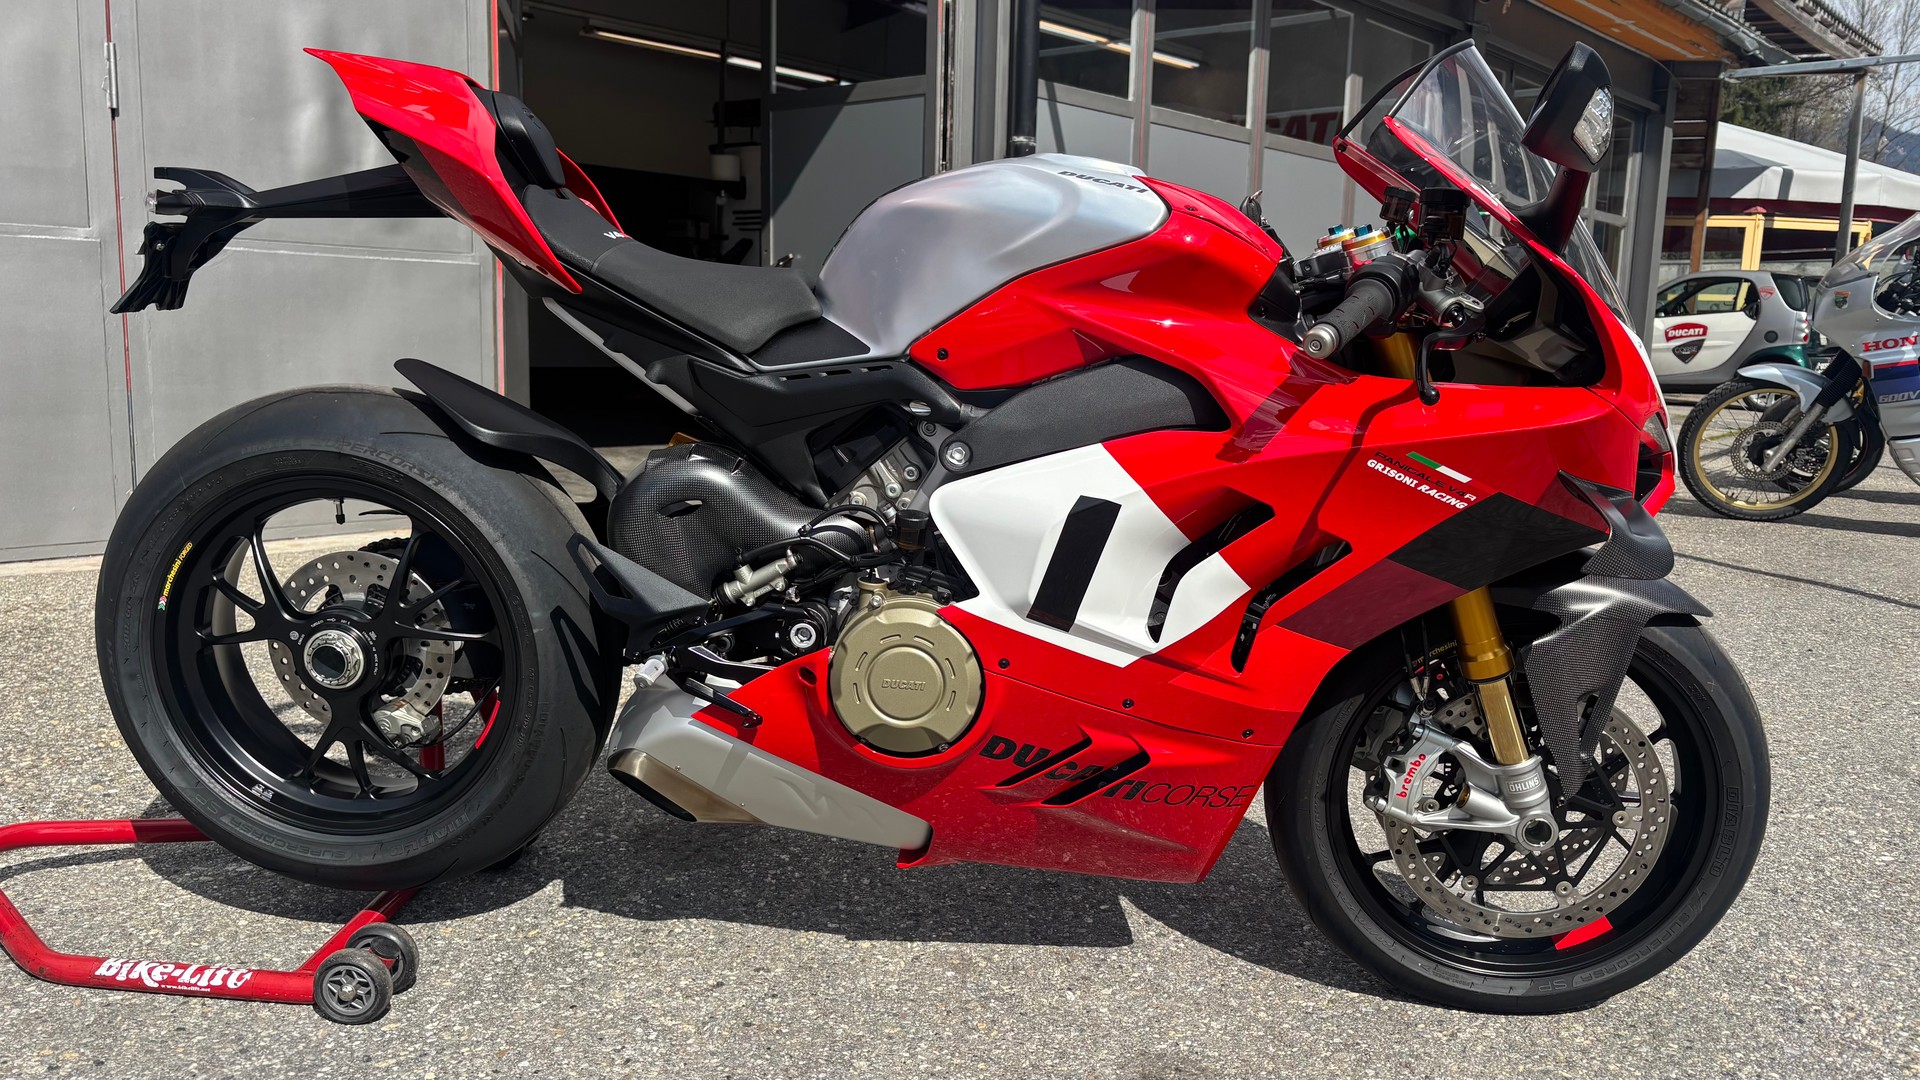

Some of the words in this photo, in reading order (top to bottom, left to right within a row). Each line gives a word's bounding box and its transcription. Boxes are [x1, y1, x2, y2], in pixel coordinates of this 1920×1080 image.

[1057, 170, 1149, 194] DUCATI
[1667, 327, 1704, 338] DUCATI
[1366, 459, 1419, 488] GRISONI
[1416, 484, 1469, 509] RACING
[1374, 451, 1446, 488] PANIGALE
[162, 558, 182, 597] marchesini
[881, 678, 926, 691] DUCATI
[1395, 753, 1427, 799] brembo
[1142, 783, 1256, 809] CORSE
